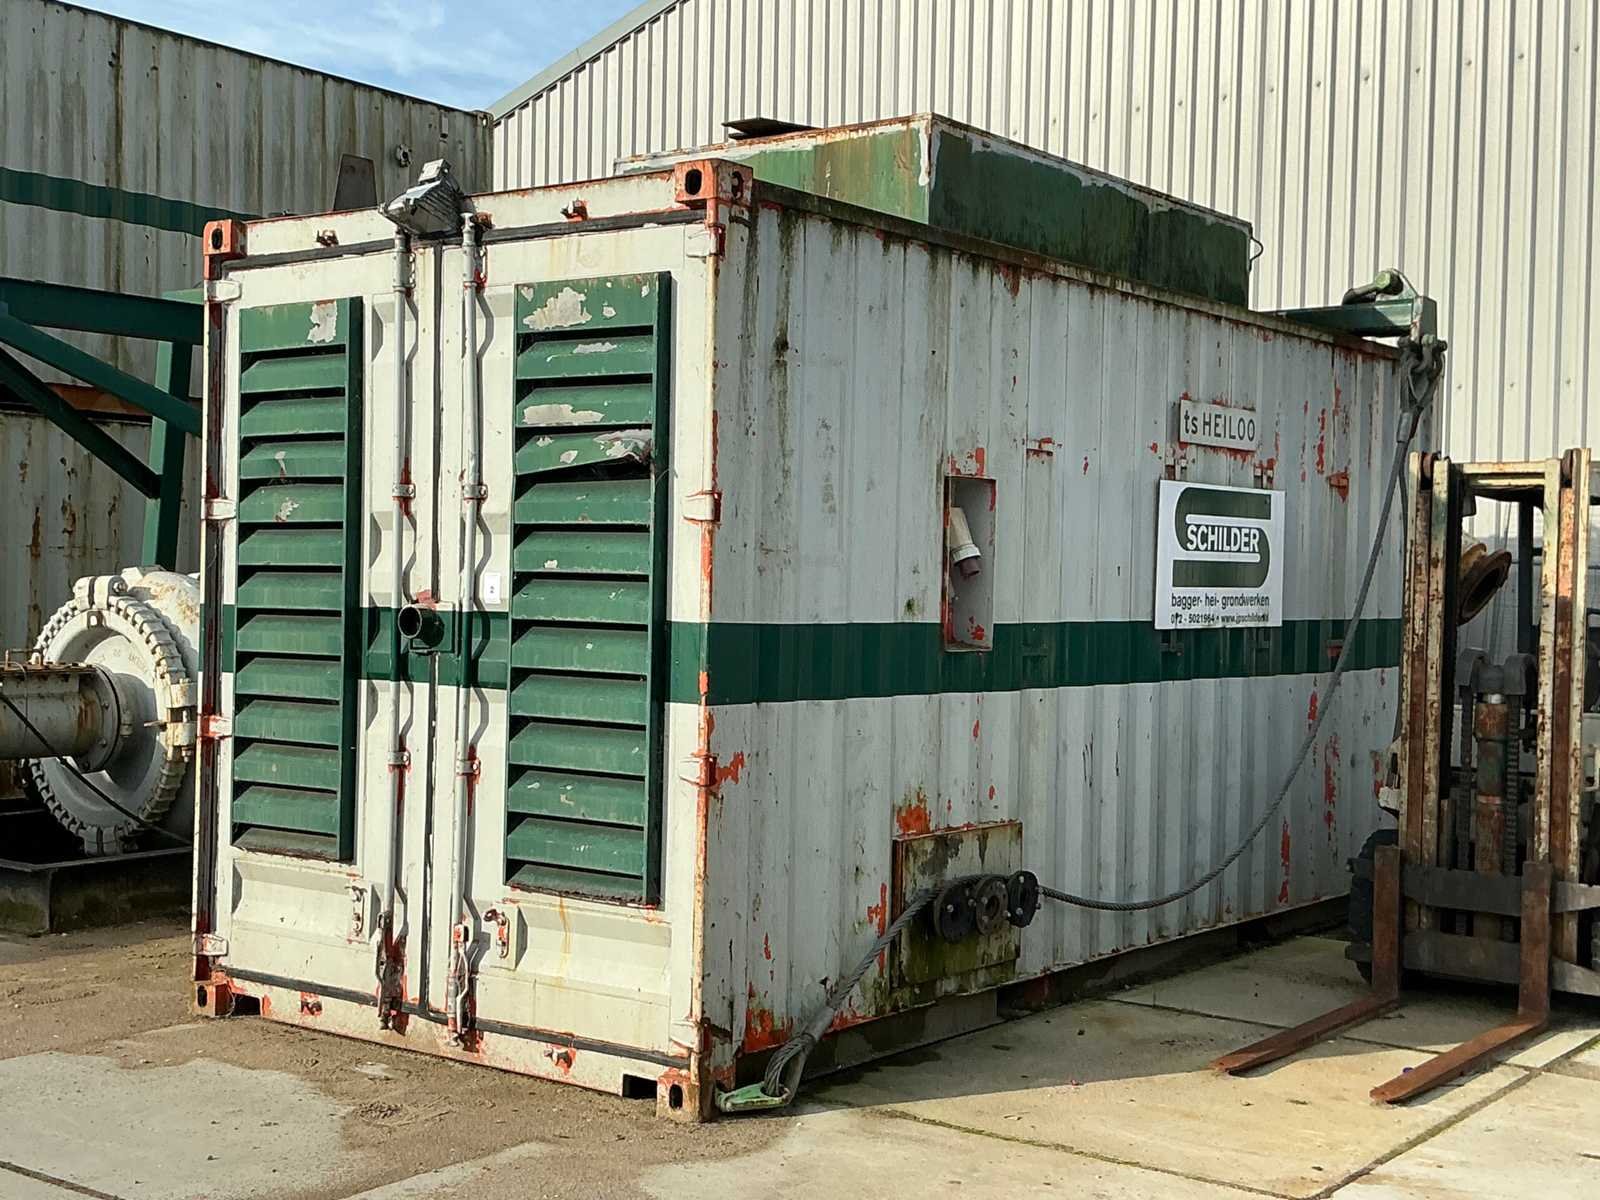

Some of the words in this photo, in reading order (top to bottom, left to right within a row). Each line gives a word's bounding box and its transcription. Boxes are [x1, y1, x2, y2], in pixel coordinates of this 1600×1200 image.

[1184, 410, 1198, 434] ts
[1202, 412, 1256, 442] HEILOO
[1186, 525, 1260, 552] SCHILDER
[1172, 593, 1202, 610] bagger-
[1205, 593, 1219, 607] hei-
[1221, 593, 1270, 609] grondwerken
